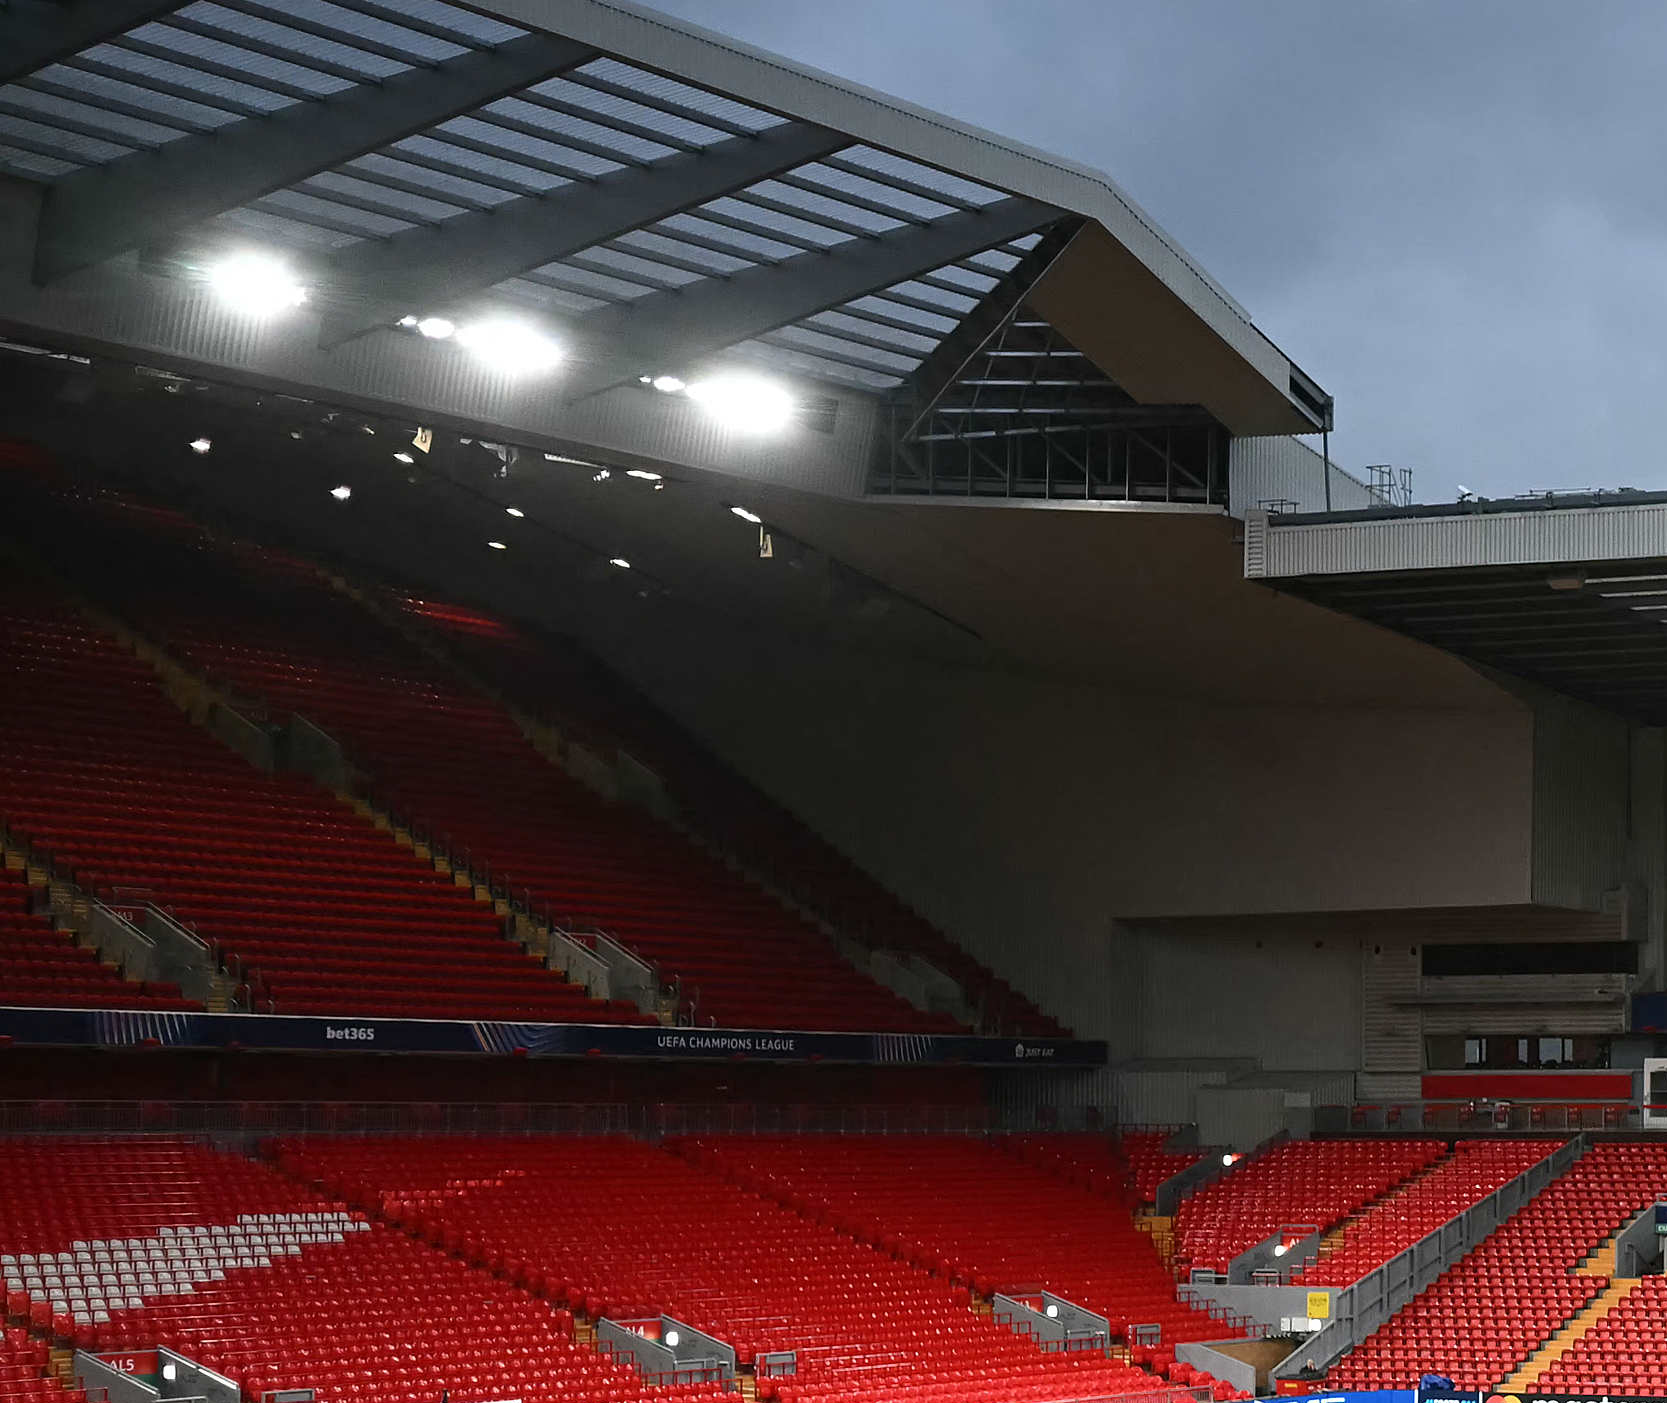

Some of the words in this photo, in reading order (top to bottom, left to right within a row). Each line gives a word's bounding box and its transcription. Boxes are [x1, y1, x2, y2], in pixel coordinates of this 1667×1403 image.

[326, 1026, 375, 1041] bet365
[658, 1036, 686, 1048] UEFA
[690, 1038, 752, 1050] CHAMPIONS
[756, 1040, 794, 1051] LEAGUE
